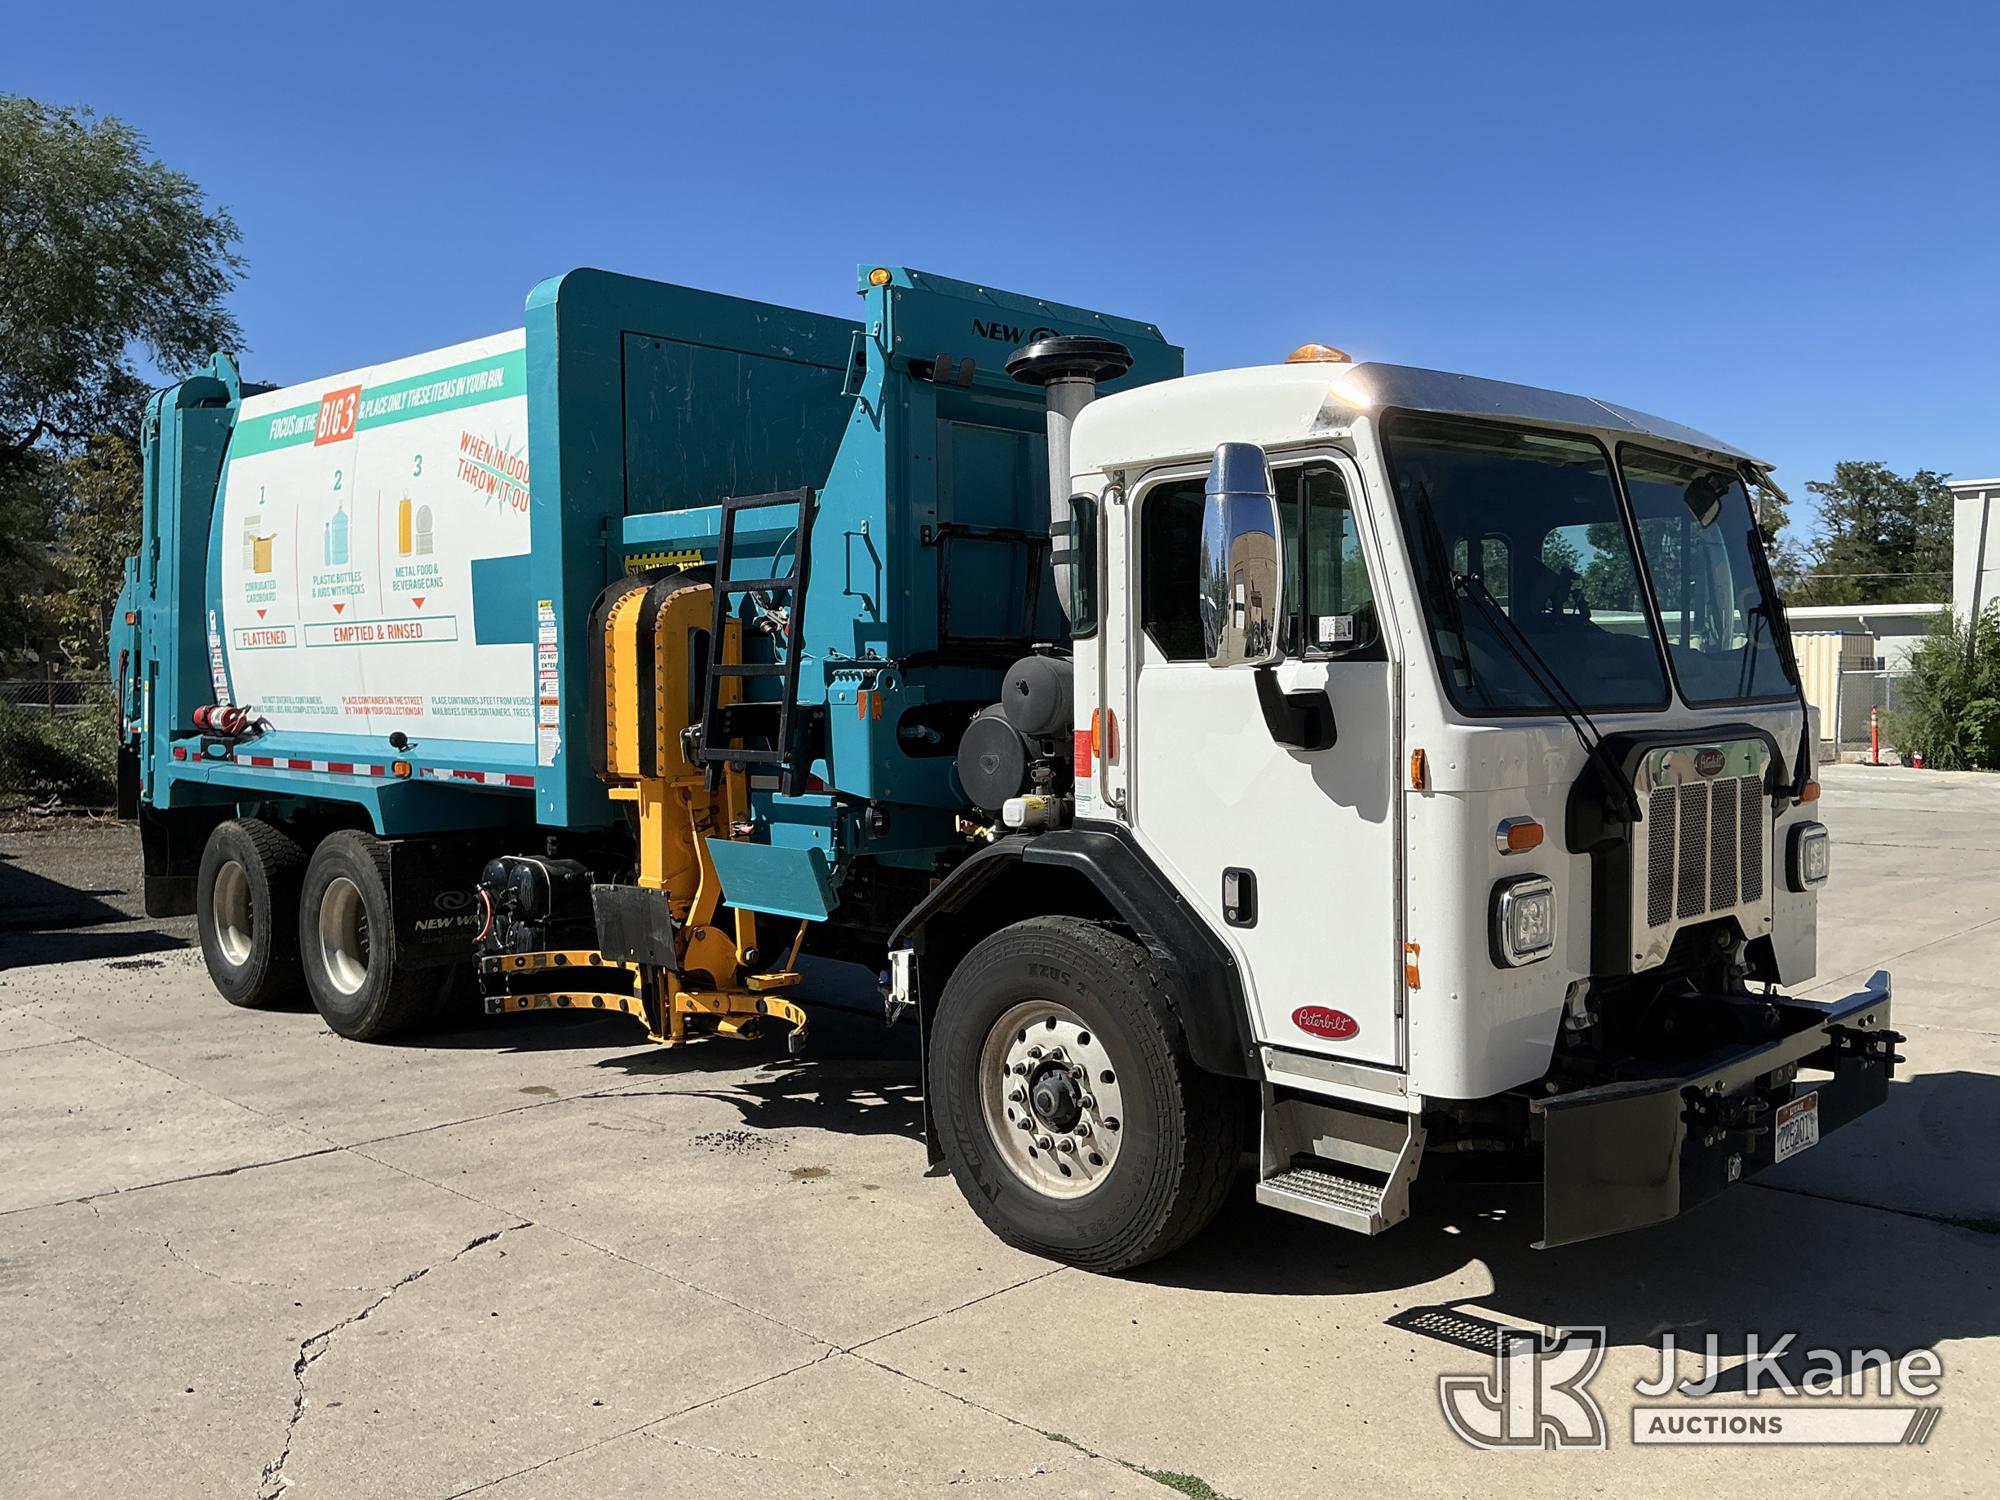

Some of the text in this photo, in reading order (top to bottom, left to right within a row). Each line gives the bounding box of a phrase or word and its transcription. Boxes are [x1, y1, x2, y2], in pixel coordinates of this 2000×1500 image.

[972, 319, 1025, 344] NEW
[269, 414, 297, 441] FOCUS
[304, 413, 318, 431] THE
[318, 398, 344, 439] BIG
[341, 393, 356, 434] 3
[365, 396, 389, 418] PLACE
[387, 391, 410, 413] ONLY
[407, 385, 433, 408] THESE
[430, 379, 457, 402] ITEMS
[465, 371, 489, 394] YOUR
[487, 367, 504, 391] BIN.
[460, 431, 494, 464] WHEN
[493, 449, 507, 471] IN
[413, 454, 422, 477] 3
[333, 469, 343, 490] 2
[457, 458, 498, 495] THROW
[498, 480, 511, 502] IT
[259, 485, 265, 505] 1
[313, 571, 362, 585] PLASTIC BOTTLES
[395, 566, 416, 577] METAL
[416, 564, 433, 576] FOOD
[331, 585, 346, 596] WITH
[346, 584, 366, 595] NECKS
[392, 577, 444, 591] BEVERAGE CANS
[243, 630, 287, 646] FLATTENED
[333, 623, 423, 643] EMPTIED & RINSED
[342, 696, 358, 704] PLACE
[358, 696, 388, 704] CONTAINERS
[394, 697, 405, 705] THE
[405, 697, 424, 705] STREET
[431, 696, 447, 705] PLACE
[448, 696, 479, 705] CONTAINERS
[484, 697, 496, 705] FEET
[497, 697, 512, 705] FROM
[371, 707, 383, 715] YOUR
[384, 707, 412, 715] COLLECTION
[412, 707, 424, 715] DAY
[462, 706, 477, 715] OTHER
[415, 917, 454, 931] NEW
[1299, 1009, 1351, 1031] Peterbilt
